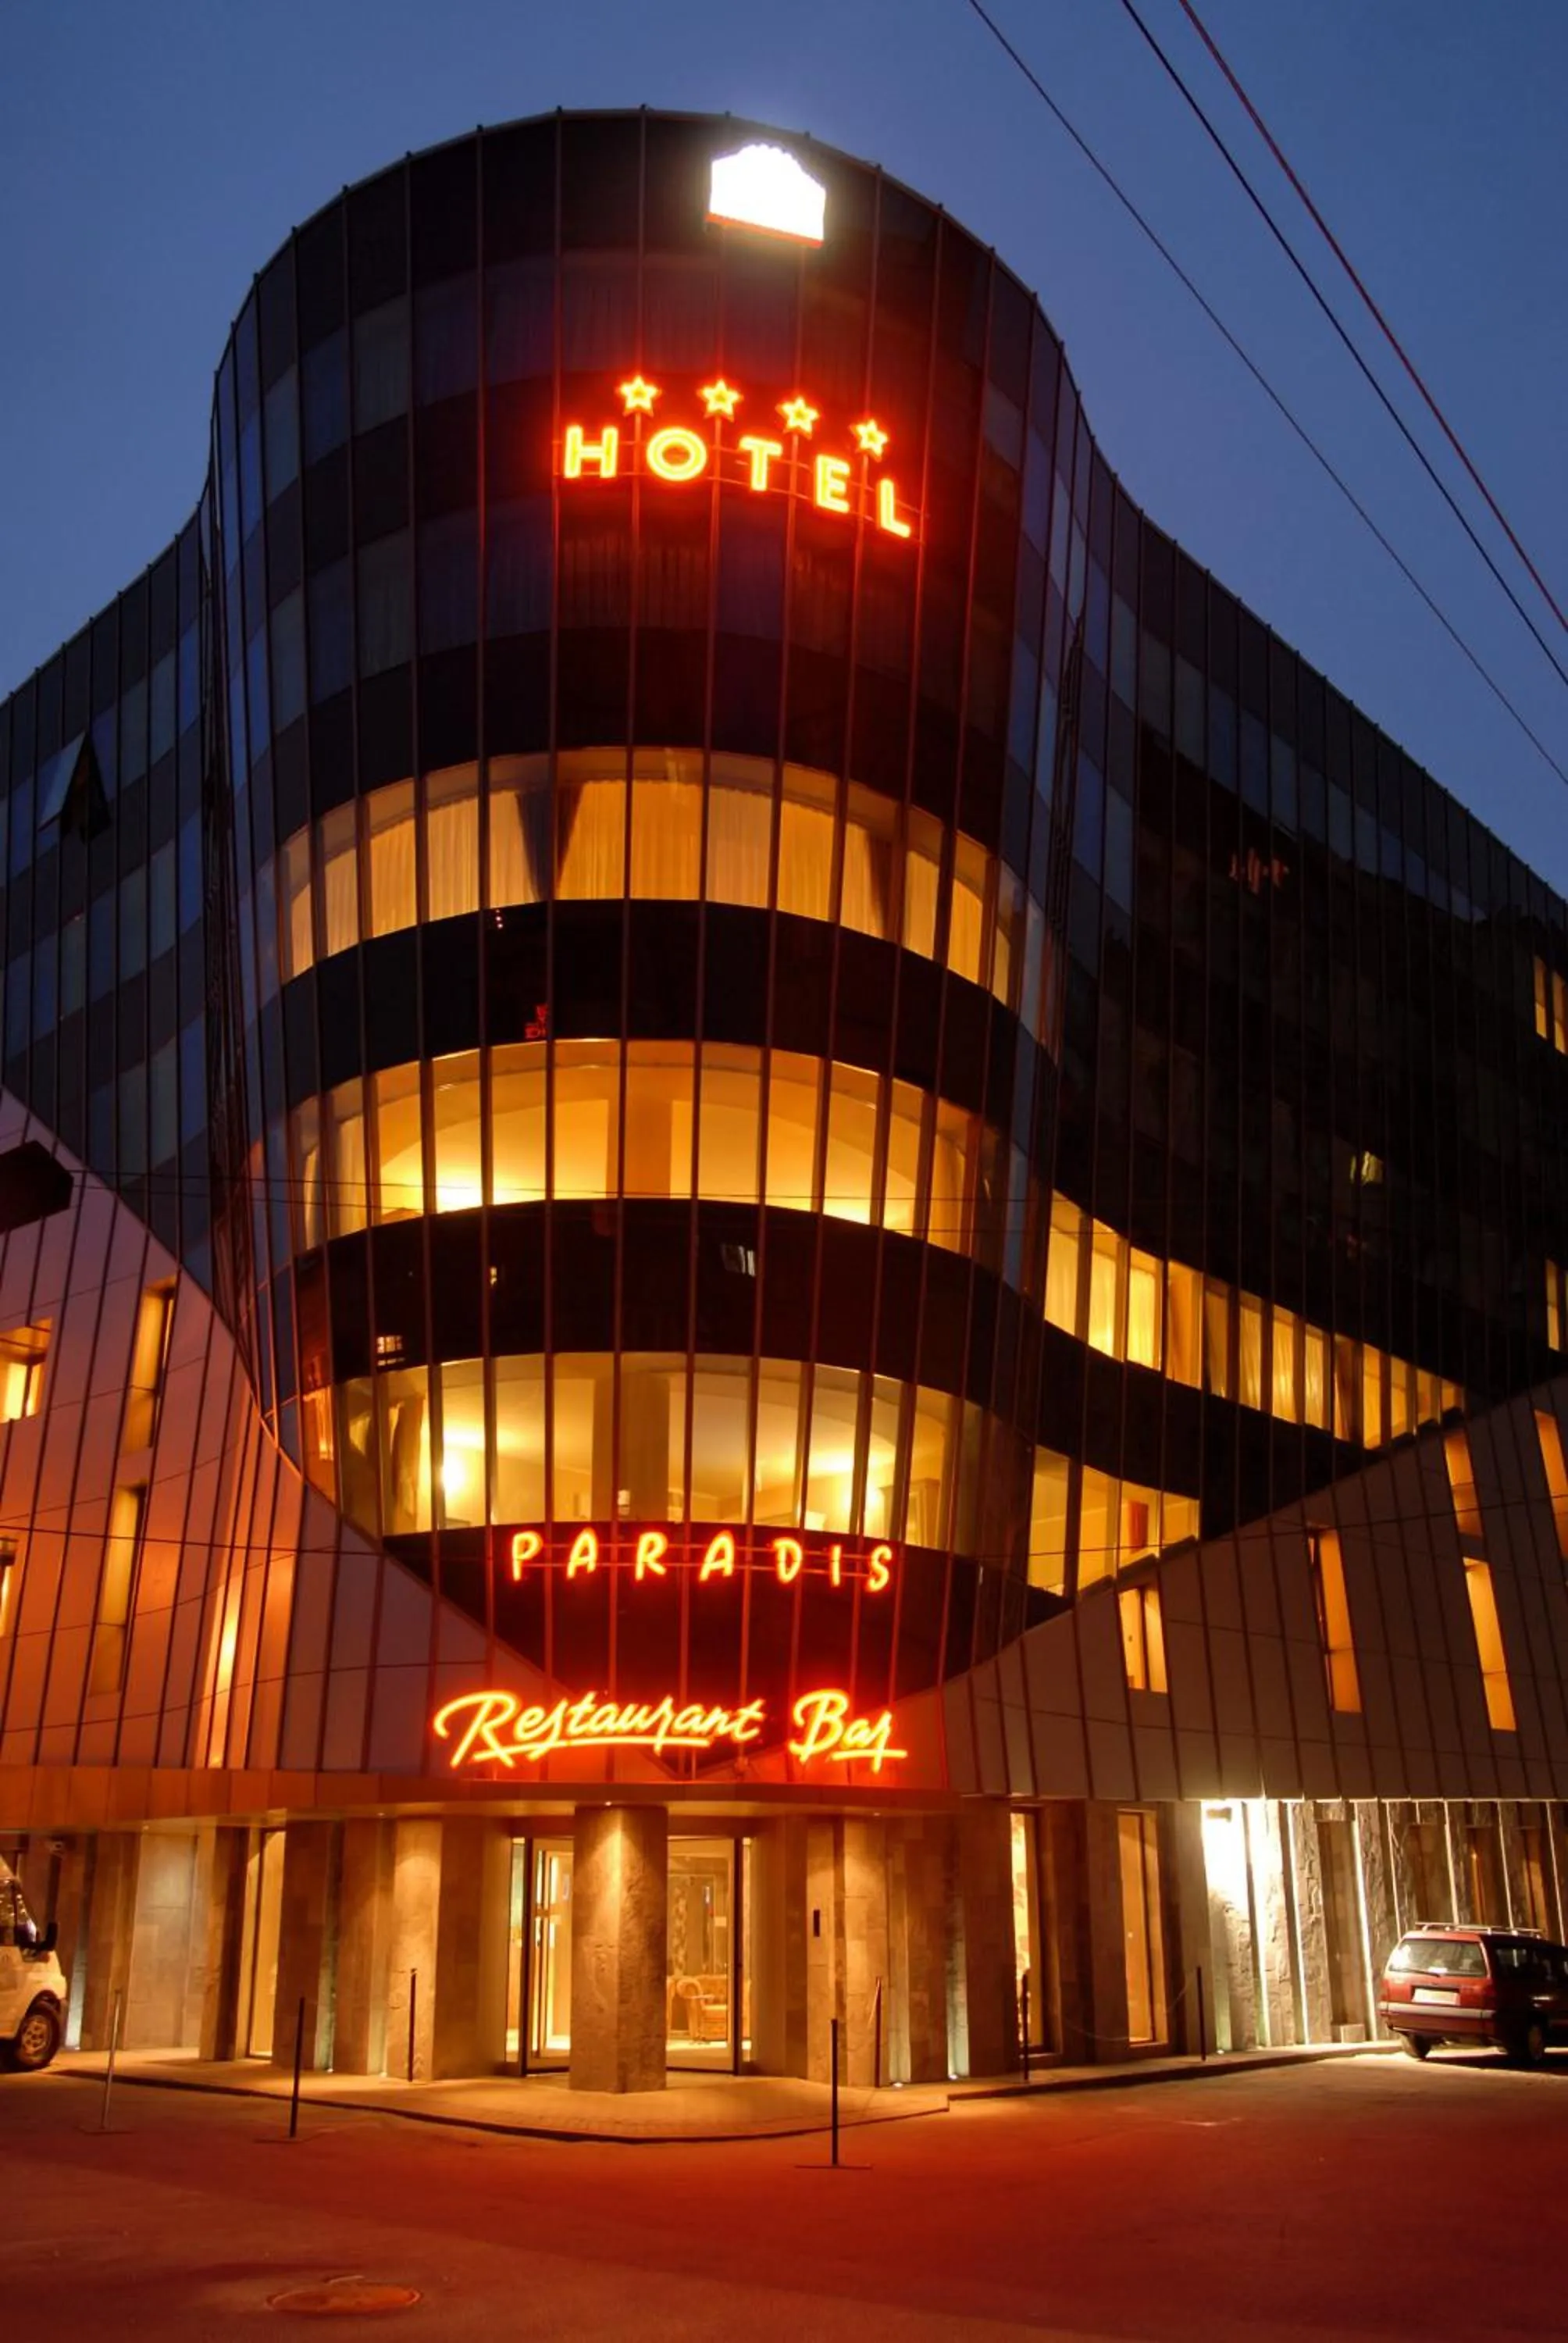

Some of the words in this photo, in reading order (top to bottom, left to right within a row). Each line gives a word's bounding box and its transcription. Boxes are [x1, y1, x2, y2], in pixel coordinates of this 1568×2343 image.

[564, 425, 911, 539] HOTEL
[511, 1528, 893, 1592] PARADIS
[433, 1690, 765, 1769] Restaurant
[788, 1689, 908, 1772] Bar
